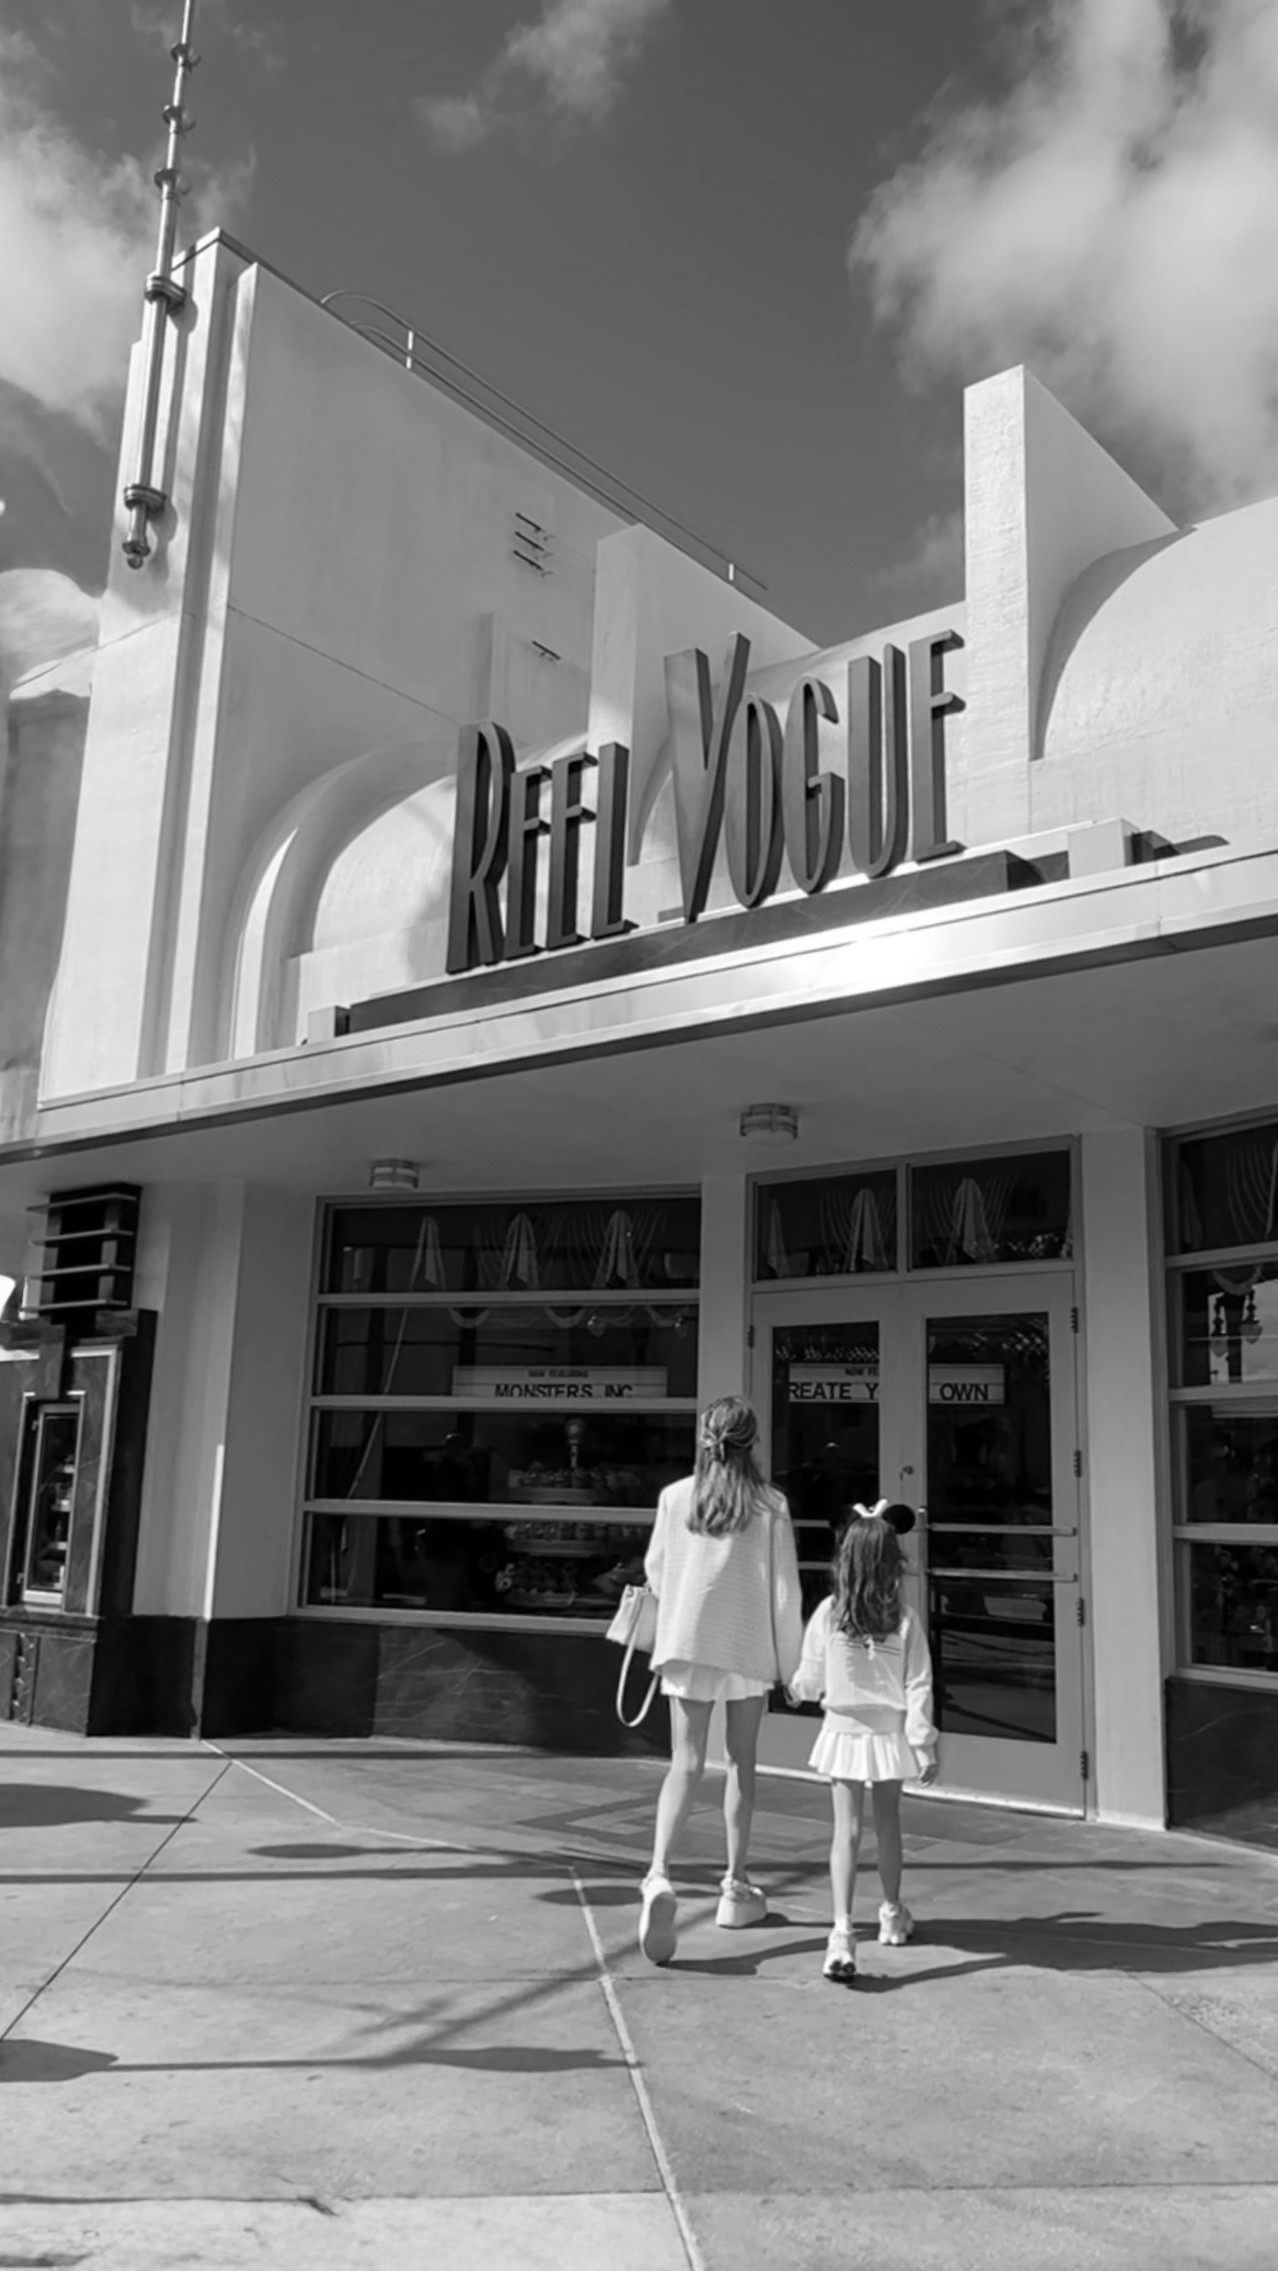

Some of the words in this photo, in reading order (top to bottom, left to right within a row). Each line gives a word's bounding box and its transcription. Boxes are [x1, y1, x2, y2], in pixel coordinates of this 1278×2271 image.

[664, 631, 966, 924] VOGUE
[494, 1383, 593, 1398] MONSTERS
[788, 1382, 852, 1400] REATE
[865, 1382, 880, 1400] Y
[939, 1382, 989, 1402] OWN
